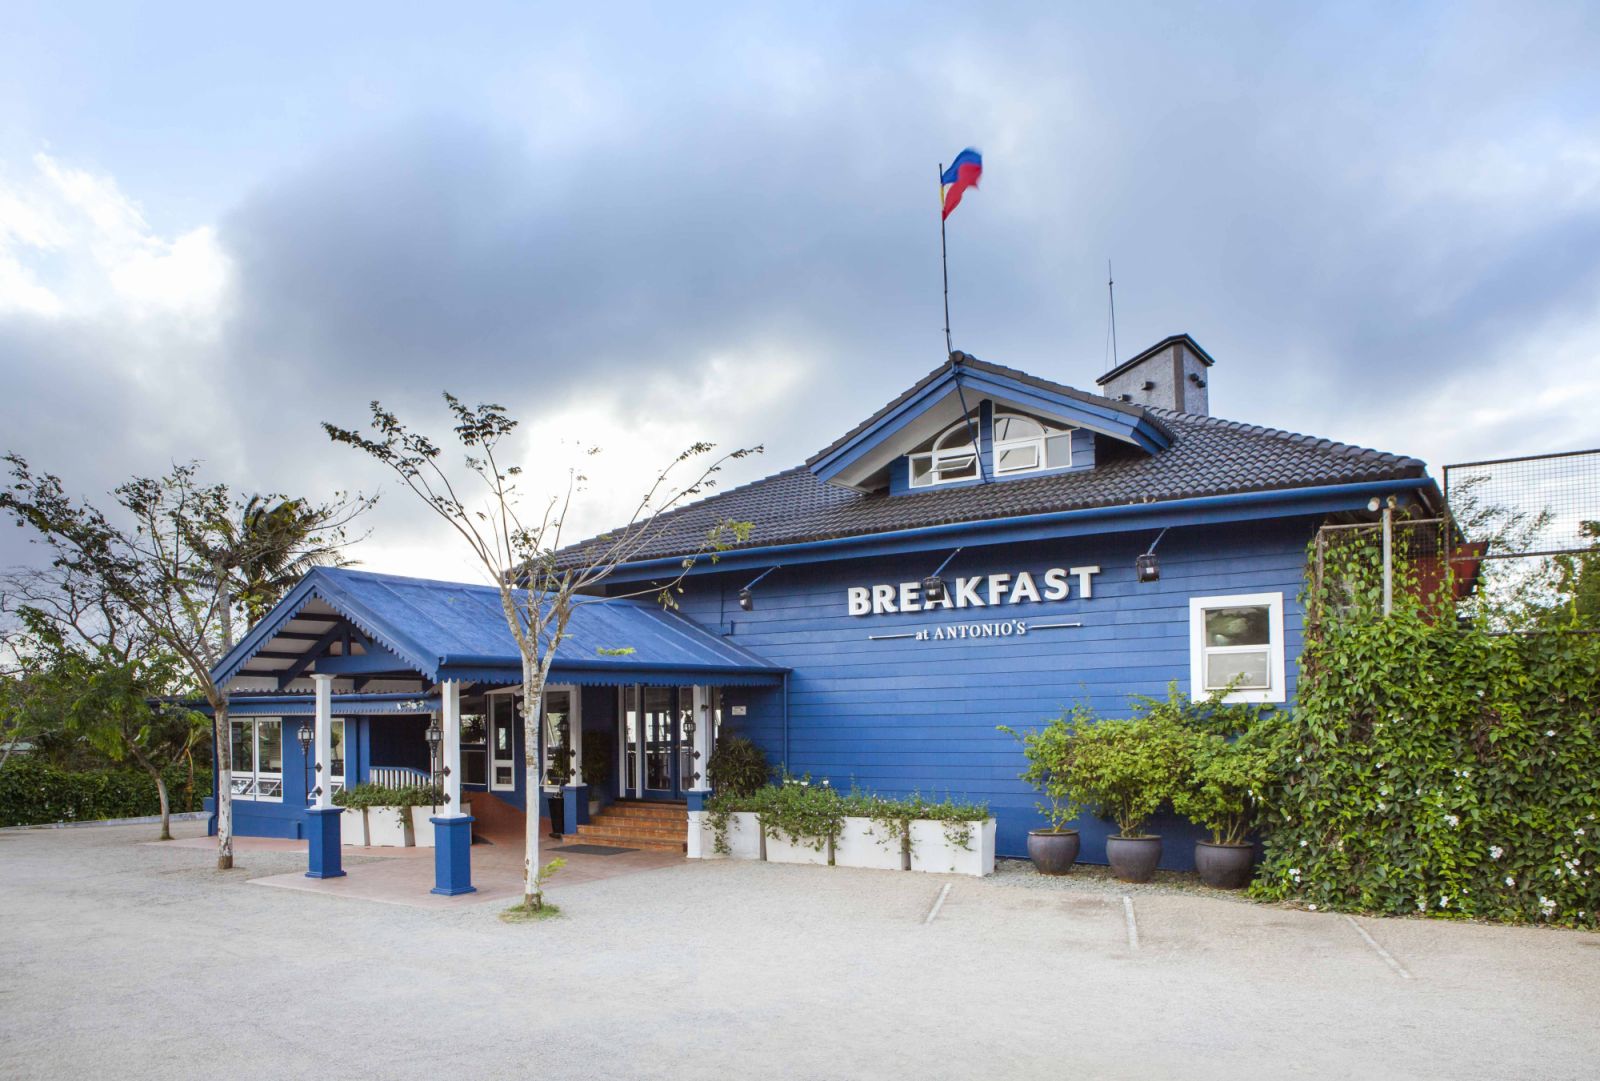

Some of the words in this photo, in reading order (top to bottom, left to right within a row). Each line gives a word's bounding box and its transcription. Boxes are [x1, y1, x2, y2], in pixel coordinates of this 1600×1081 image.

[848, 565, 1100, 616] BREAKFAST
[915, 629, 929, 640] at
[934, 620, 1026, 640] ANTONIO'S
